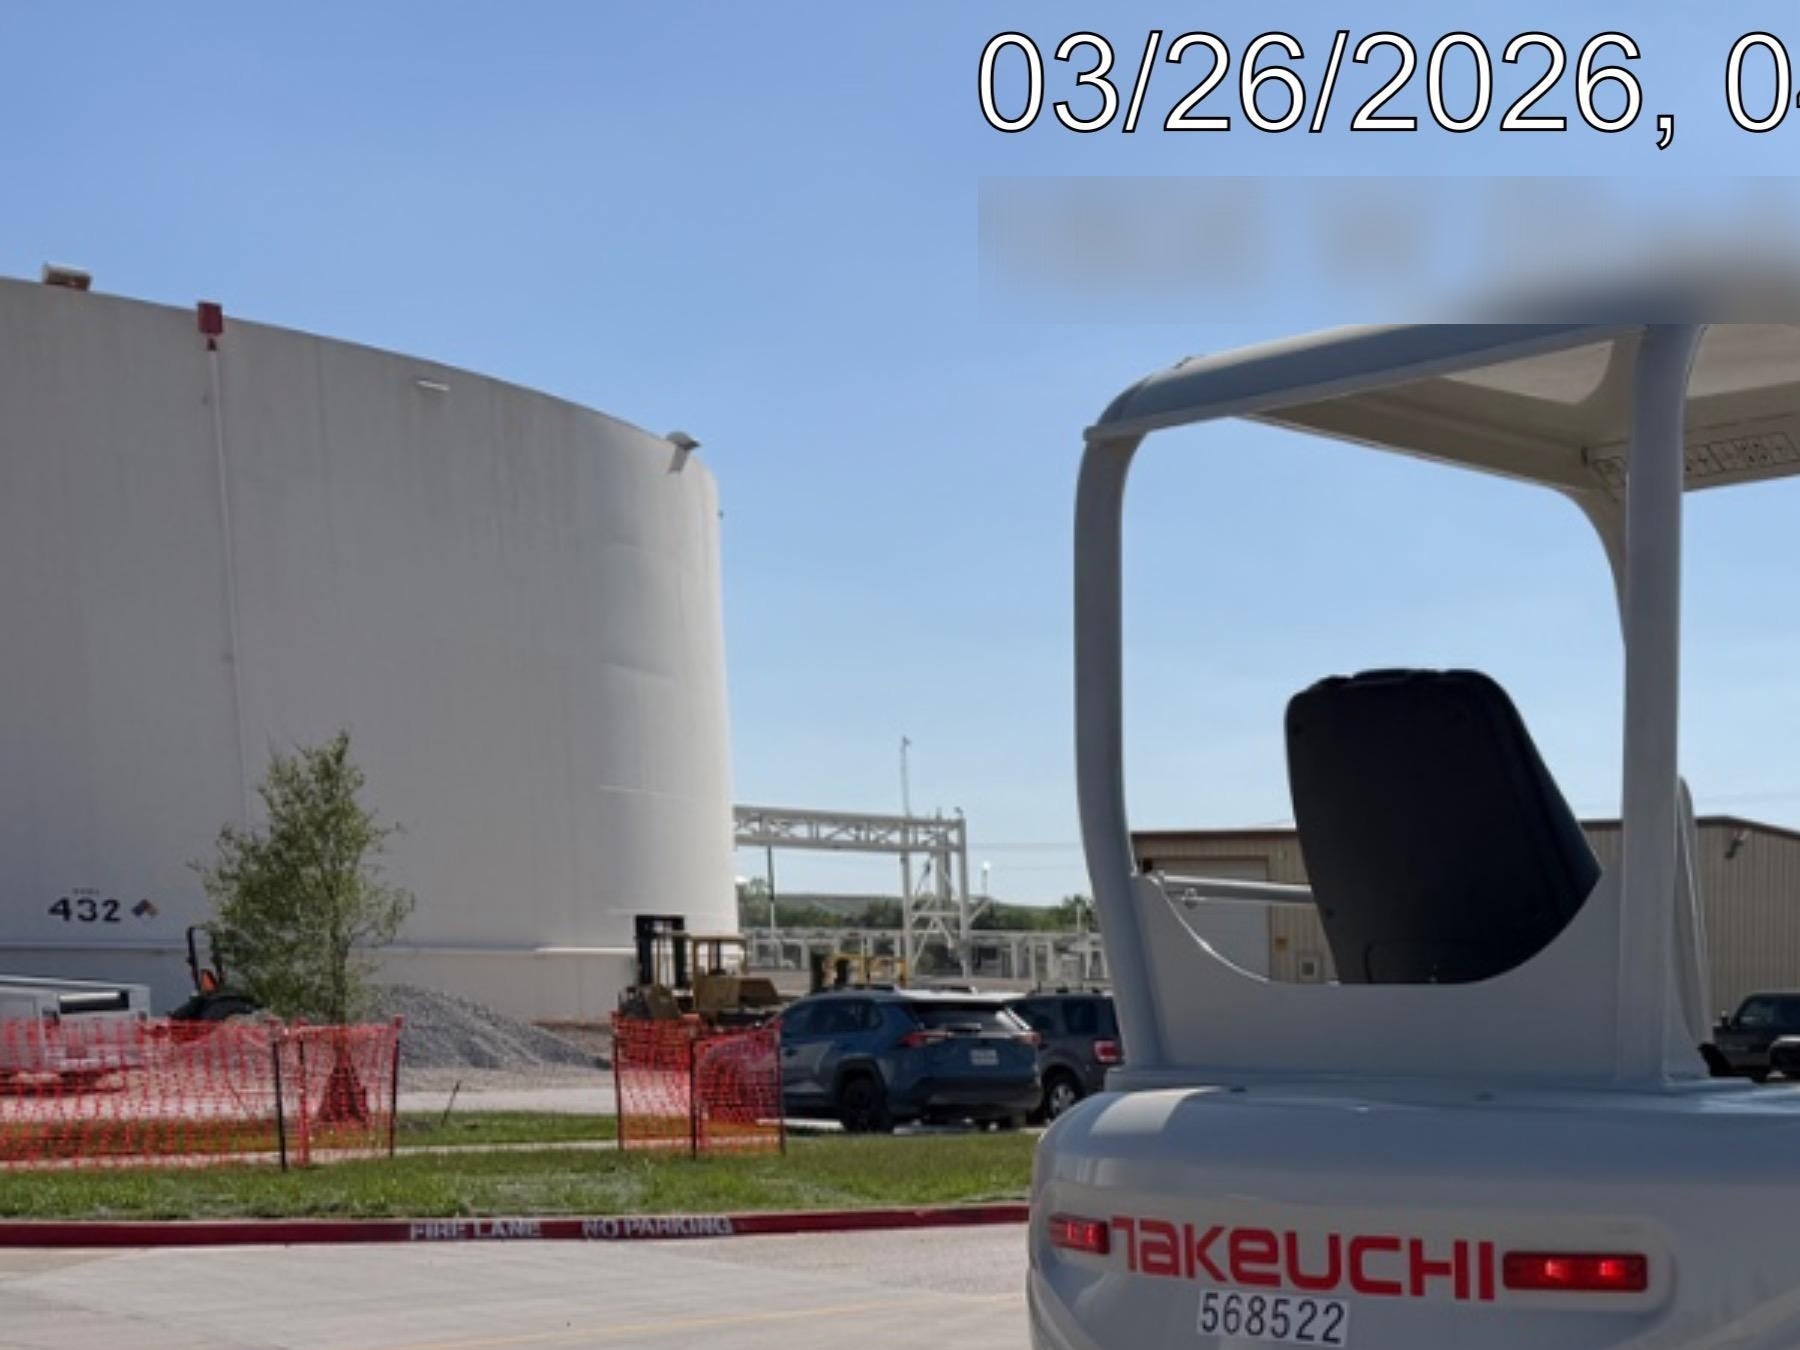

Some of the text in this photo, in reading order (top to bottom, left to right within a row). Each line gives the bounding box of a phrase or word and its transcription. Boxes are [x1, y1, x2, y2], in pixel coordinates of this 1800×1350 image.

[48, 896, 121, 922] 432
[474, 1219, 541, 1240] LANE
[582, 1216, 619, 1238] NO
[624, 1214, 733, 1237] PARKING
[1202, 1293, 1345, 1344] 568522
